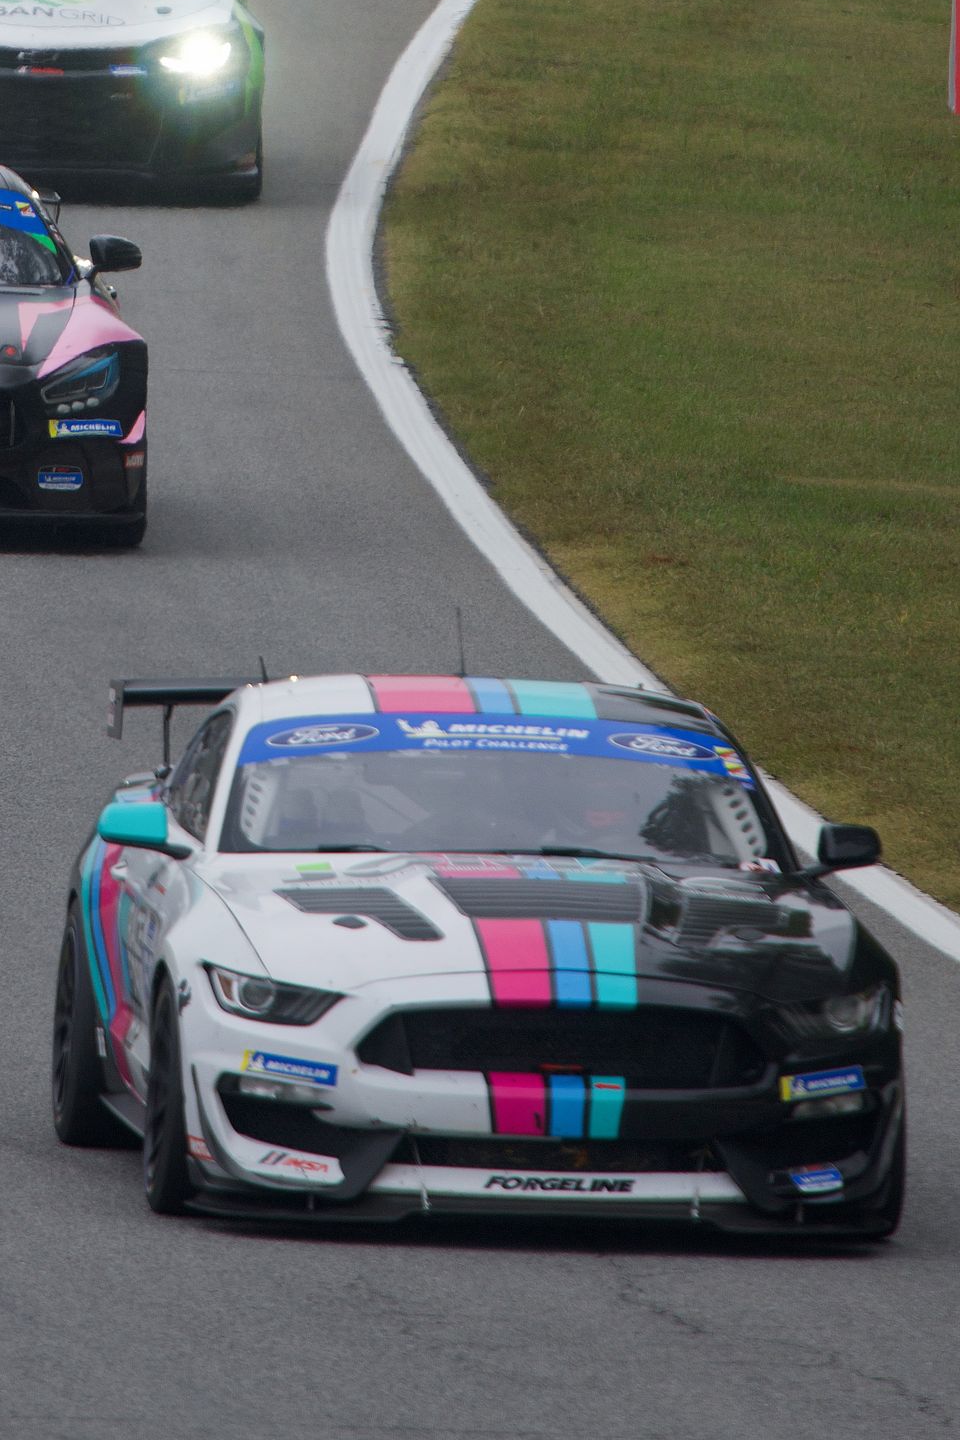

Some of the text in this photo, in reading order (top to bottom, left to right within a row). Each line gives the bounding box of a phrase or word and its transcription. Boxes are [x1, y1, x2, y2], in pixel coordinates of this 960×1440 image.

[70, 423, 116, 431] MICHELIN
[287, 727, 358, 746] Ford
[448, 723, 590, 739] MICHELIN
[423, 738, 569, 752] PILOT CHALLENGE
[629, 735, 699, 757] Ford
[264, 1060, 331, 1080] MICHELIN
[484, 1175, 636, 1192] FORGELINE
